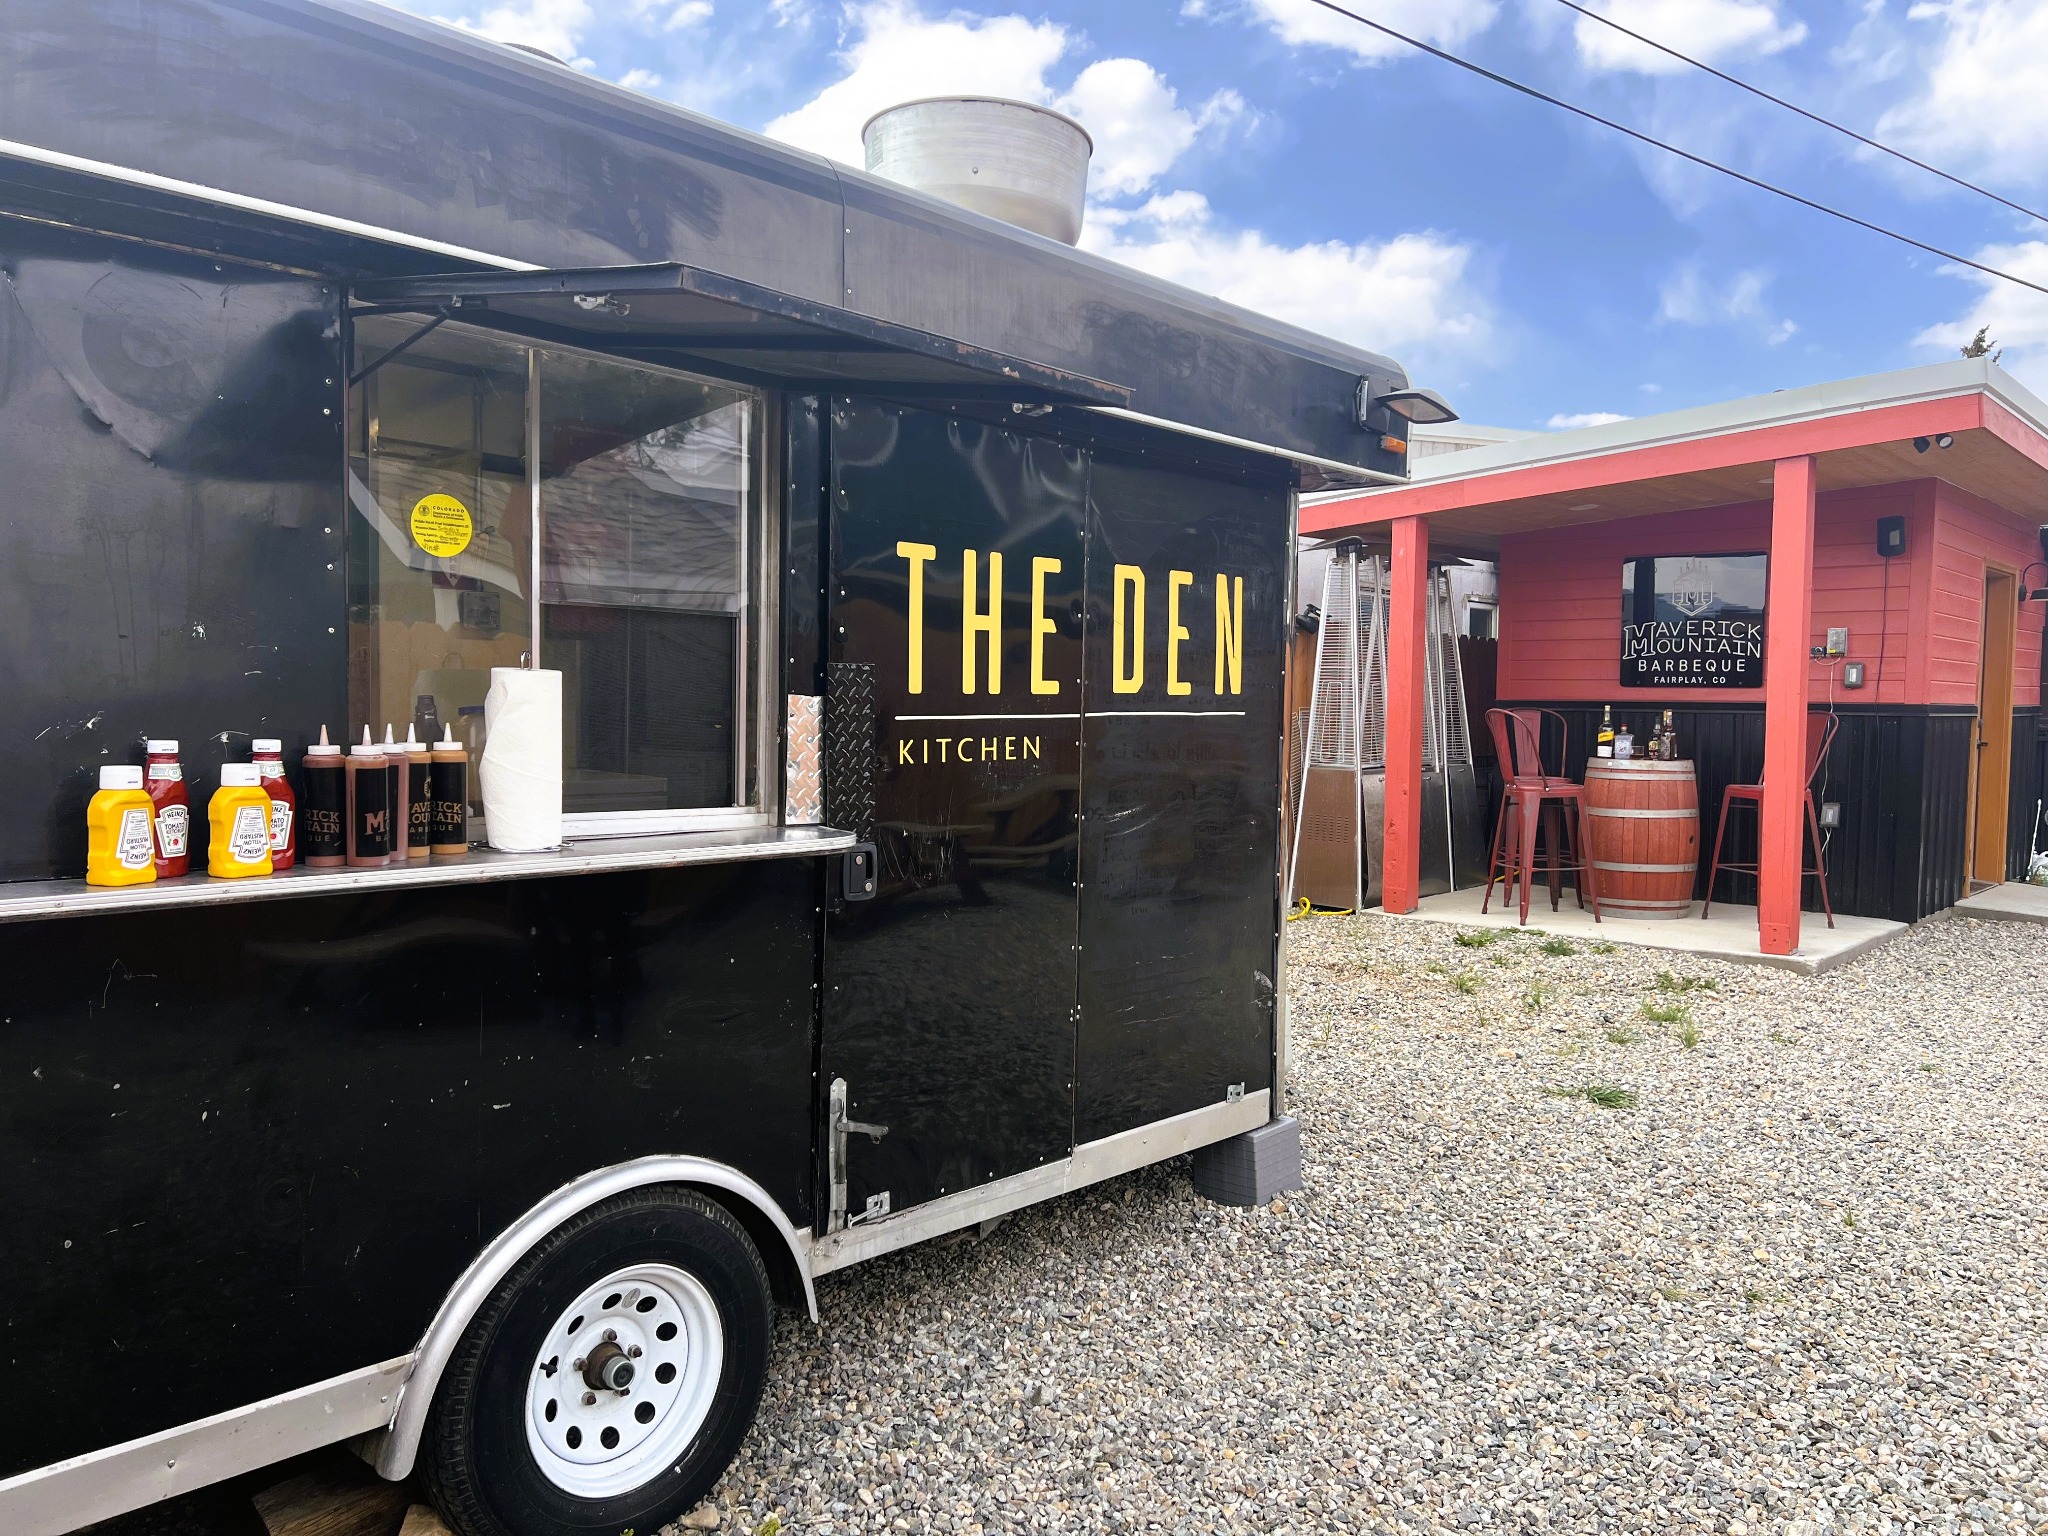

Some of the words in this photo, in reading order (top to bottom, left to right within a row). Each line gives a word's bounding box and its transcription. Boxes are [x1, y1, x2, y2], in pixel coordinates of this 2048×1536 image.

[433, 505, 465, 513] COLORADO
[896, 541, 1062, 695] THE
[1112, 563, 1244, 696] DEN
[1623, 620, 1761, 660] MAVERICK
[1631, 637, 1761, 659] MOUNTAIN
[1638, 659, 1746, 673] BARBEQUE
[1654, 676, 1707, 685] FAIRPLAY,
[1712, 676, 1726, 684] CO
[899, 735, 1041, 765] KITCHEN
[166, 811, 184, 819] HEINZ
[126, 836, 149, 845] MUSTARD
[243, 847, 262, 855] HEINZ
[129, 852, 147, 860] HEINZ
